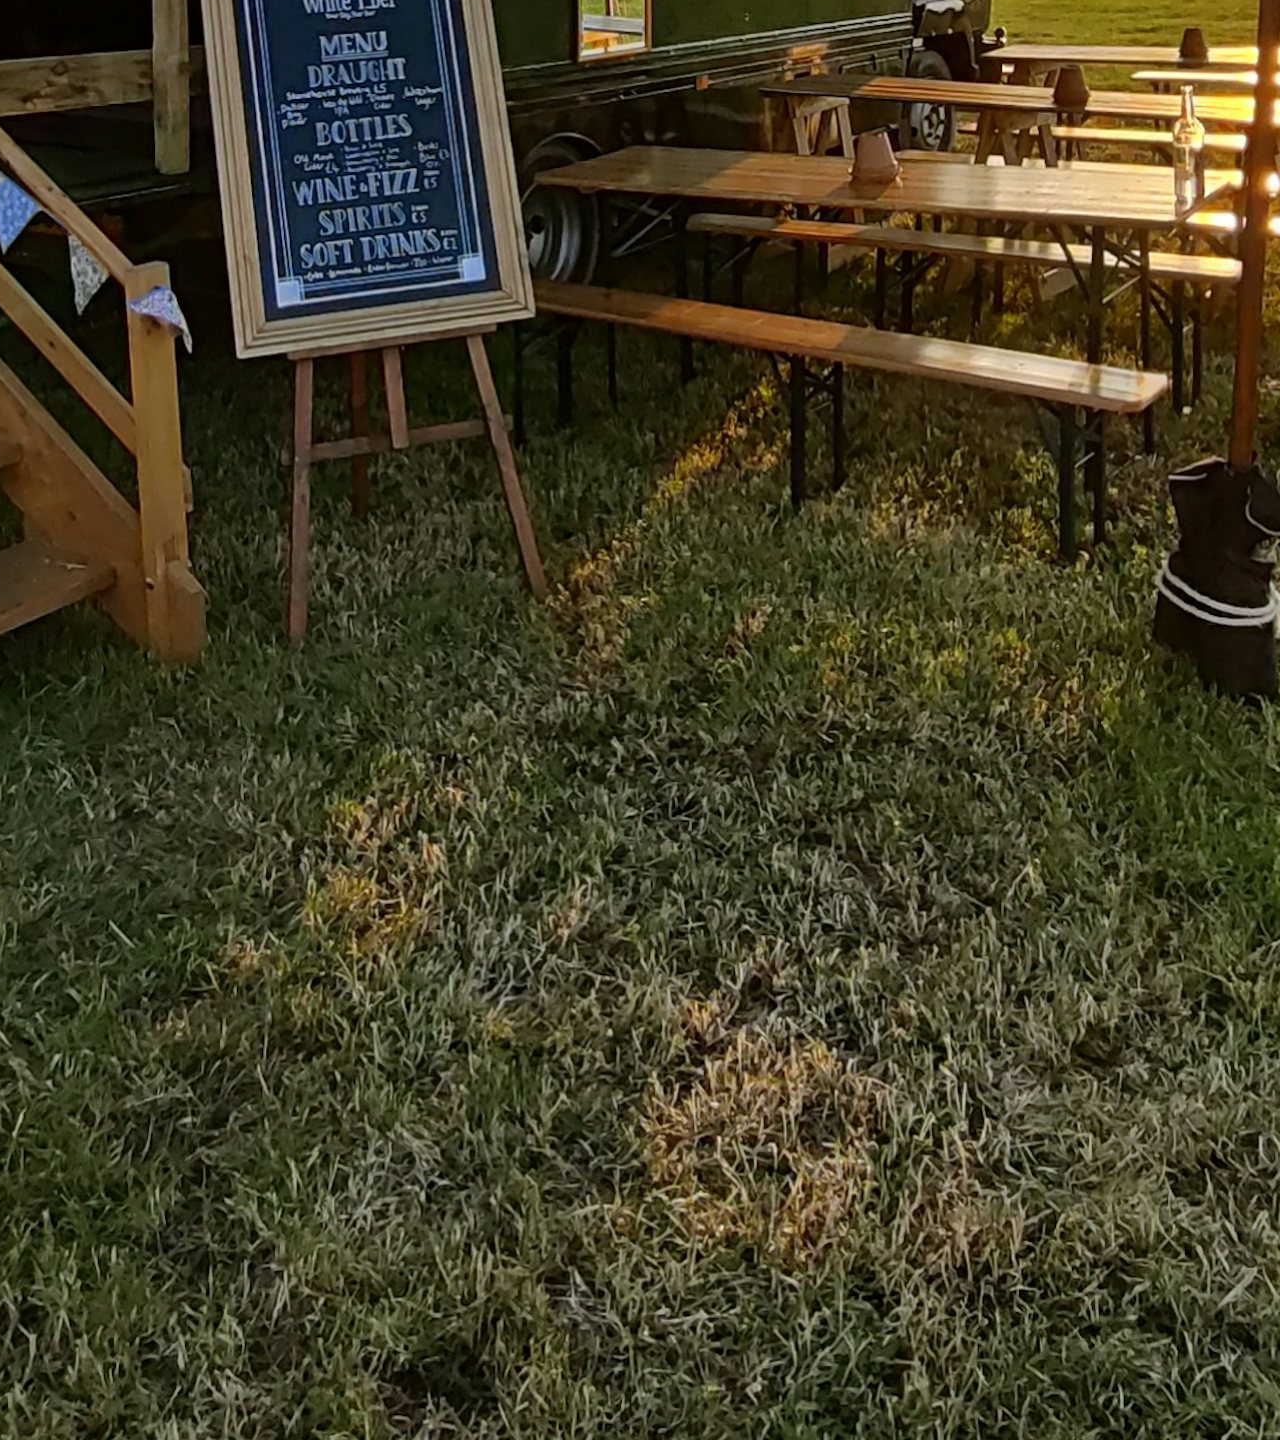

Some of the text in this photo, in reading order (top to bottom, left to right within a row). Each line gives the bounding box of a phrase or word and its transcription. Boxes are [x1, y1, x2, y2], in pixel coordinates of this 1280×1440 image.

[319, 31, 388, 57] MENU
[307, 58, 407, 88] DRAUGHT
[315, 114, 413, 146] BOTTLES
[292, 174, 360, 206] WINE
[367, 168, 420, 197] FIZZ
[318, 201, 406, 236] SPIRITS
[300, 239, 354, 269] SOFT
[360, 228, 441, 261] DRINKS
